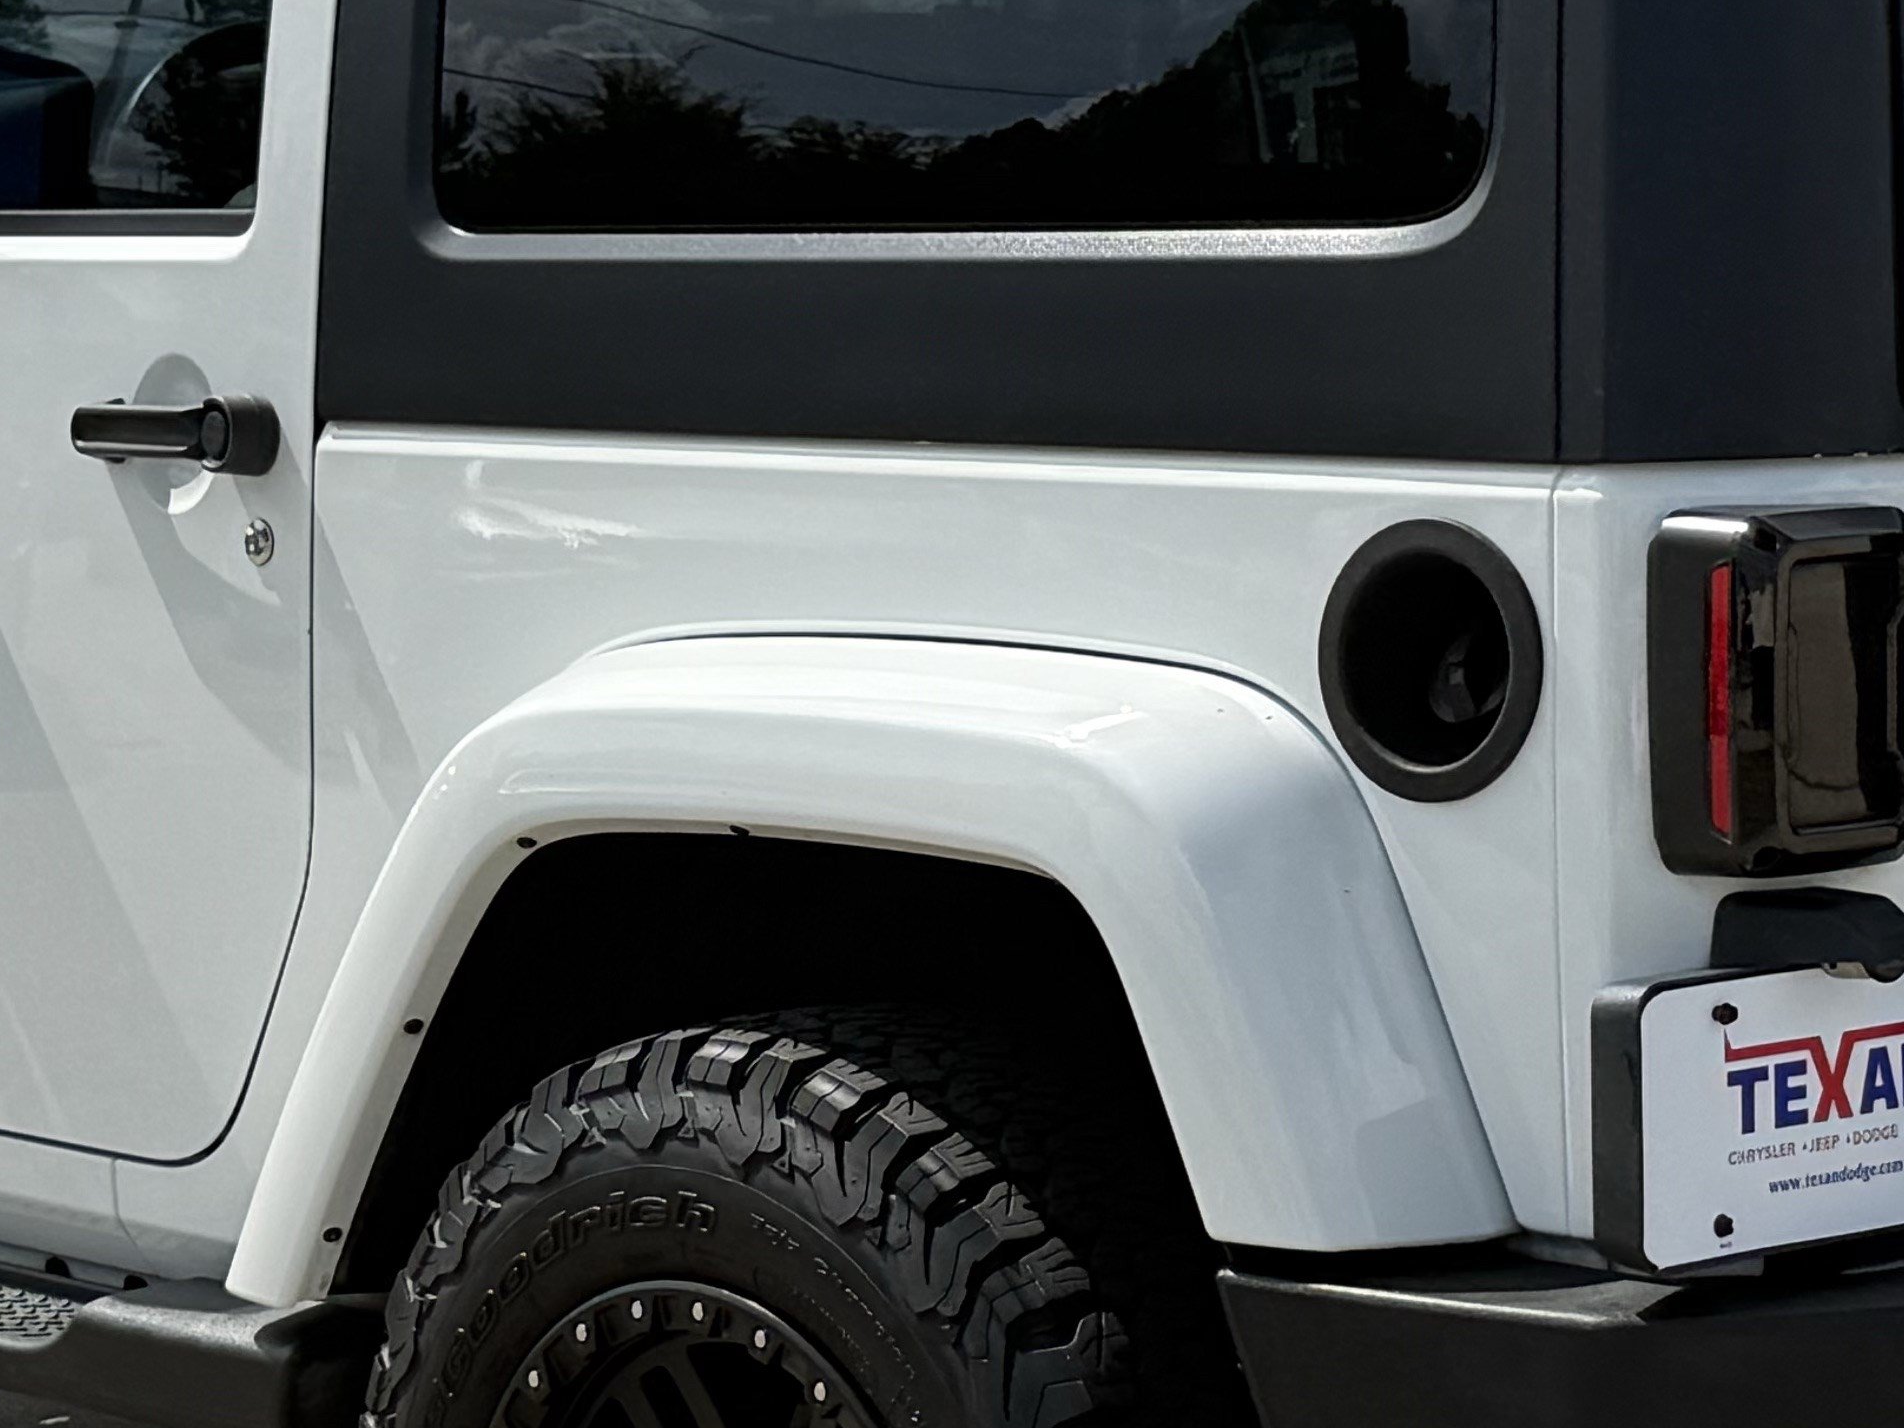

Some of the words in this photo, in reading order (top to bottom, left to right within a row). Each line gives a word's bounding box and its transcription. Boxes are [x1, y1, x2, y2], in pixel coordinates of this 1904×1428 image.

[1728, 1141, 1796, 1166] CHRYSLER
[1852, 1122, 1899, 1146] DODGE
[1768, 1159, 1904, 1194] www.texandodge.com
